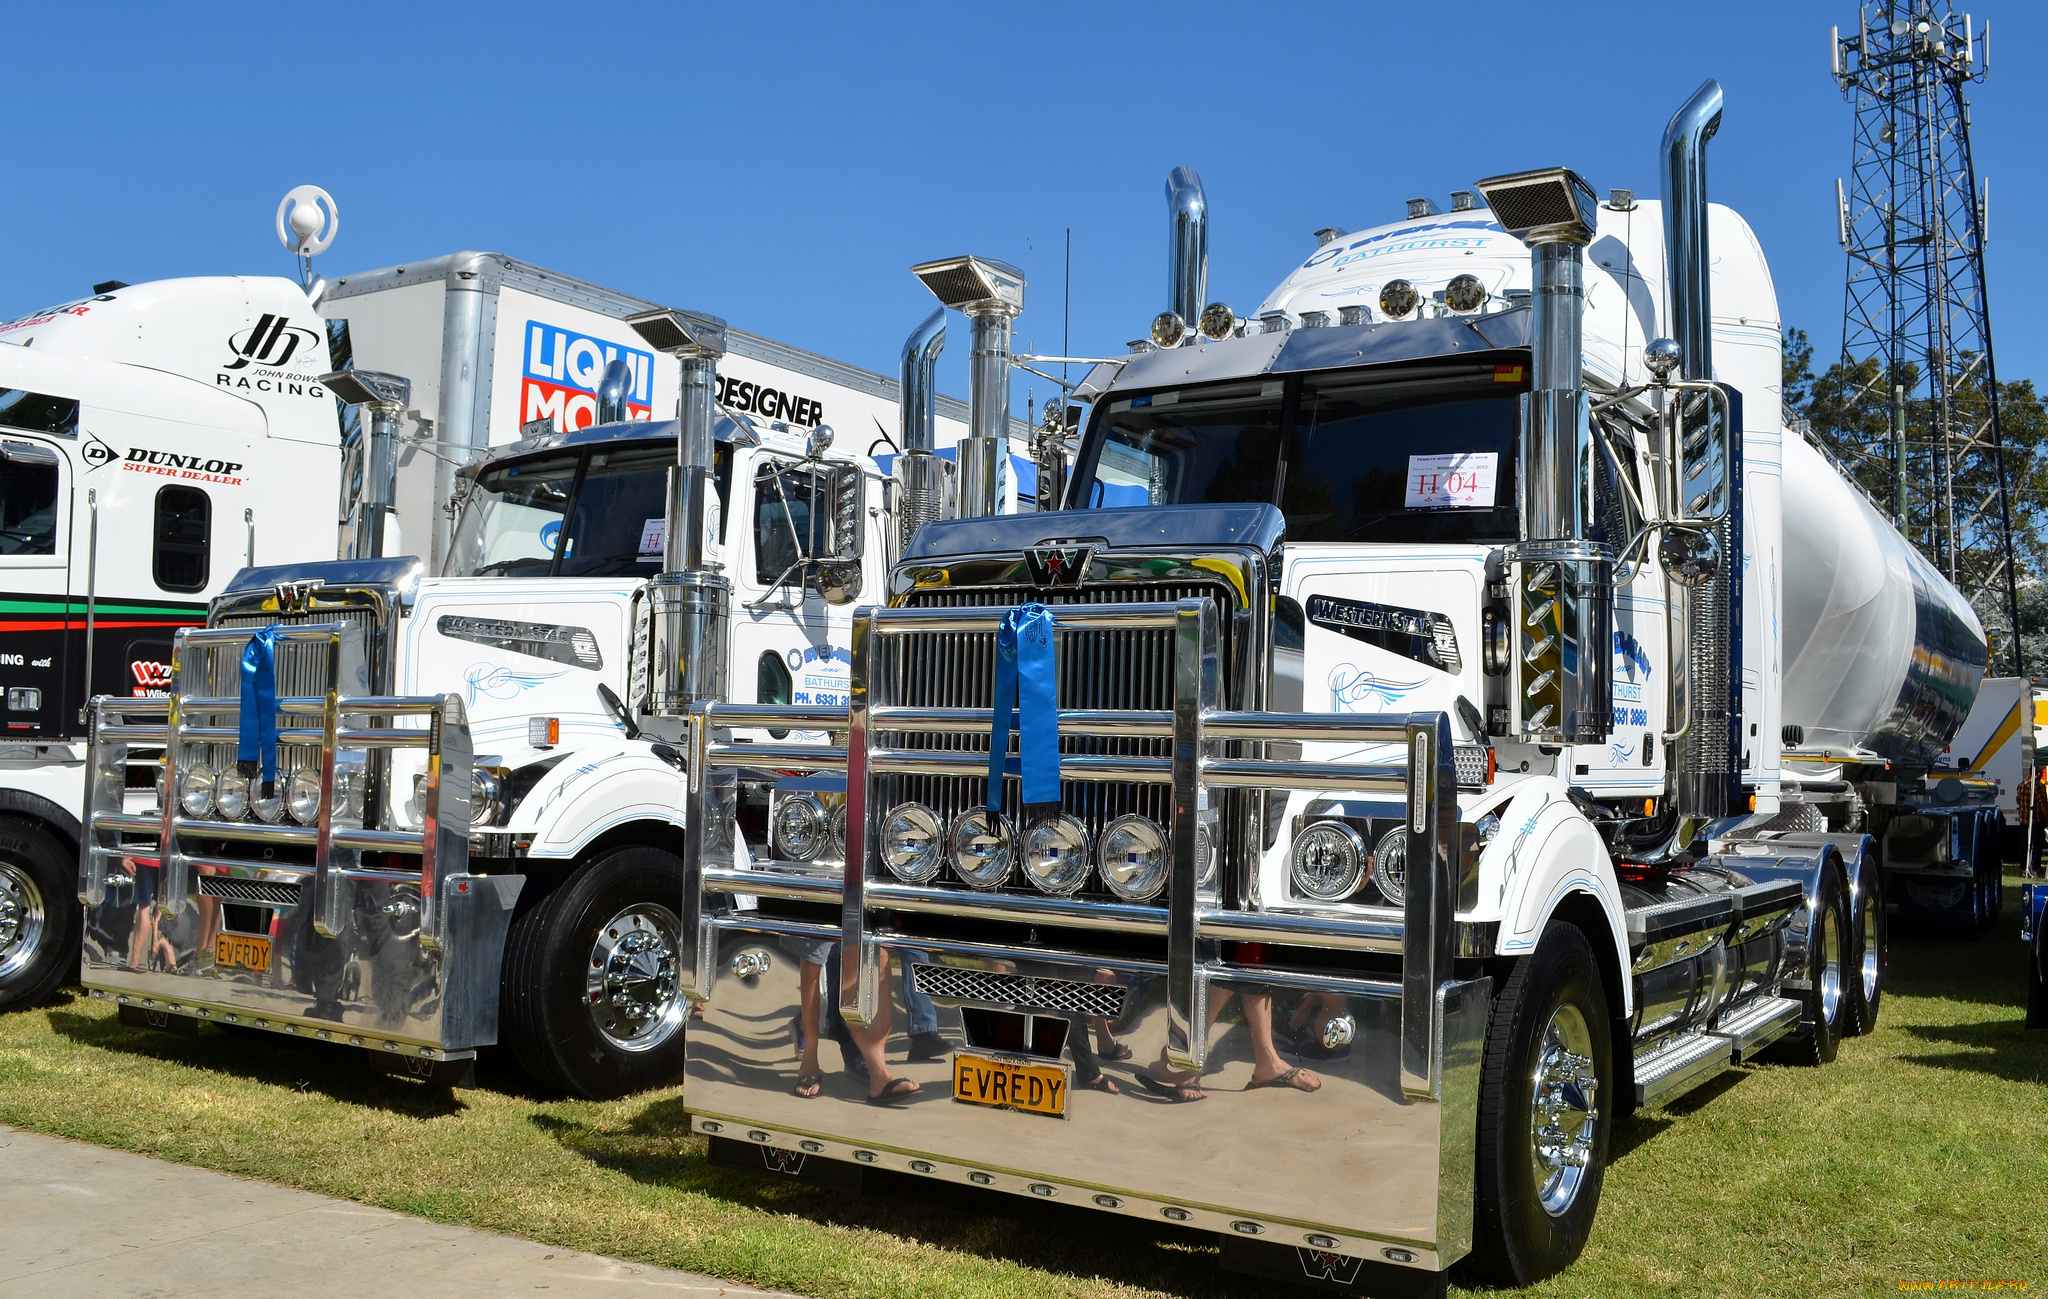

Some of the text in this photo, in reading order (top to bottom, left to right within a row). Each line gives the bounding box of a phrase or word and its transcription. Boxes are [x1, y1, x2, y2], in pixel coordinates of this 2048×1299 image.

[1332, 239, 1491, 267] BATHURST
[252, 368, 285, 379] JOHN
[216, 373, 325, 399] RACING
[124, 448, 243, 475] DUNLOP
[123, 463, 242, 486] SUPER DEALER
[1418, 473, 1440, 495] H
[1448, 472, 1478, 494] 04
[646, 532, 661, 548] H
[1313, 598, 1391, 630] WESTERN
[0, 653, 52, 668] ING with
[804, 677, 850, 690] BATHURS
[1613, 684, 1641, 699] THURST
[794, 692, 812, 704] PH.
[815, 694, 838, 707] 6331
[218, 941, 269, 968] EVERDY
[959, 1065, 1063, 1110] EVREDY
